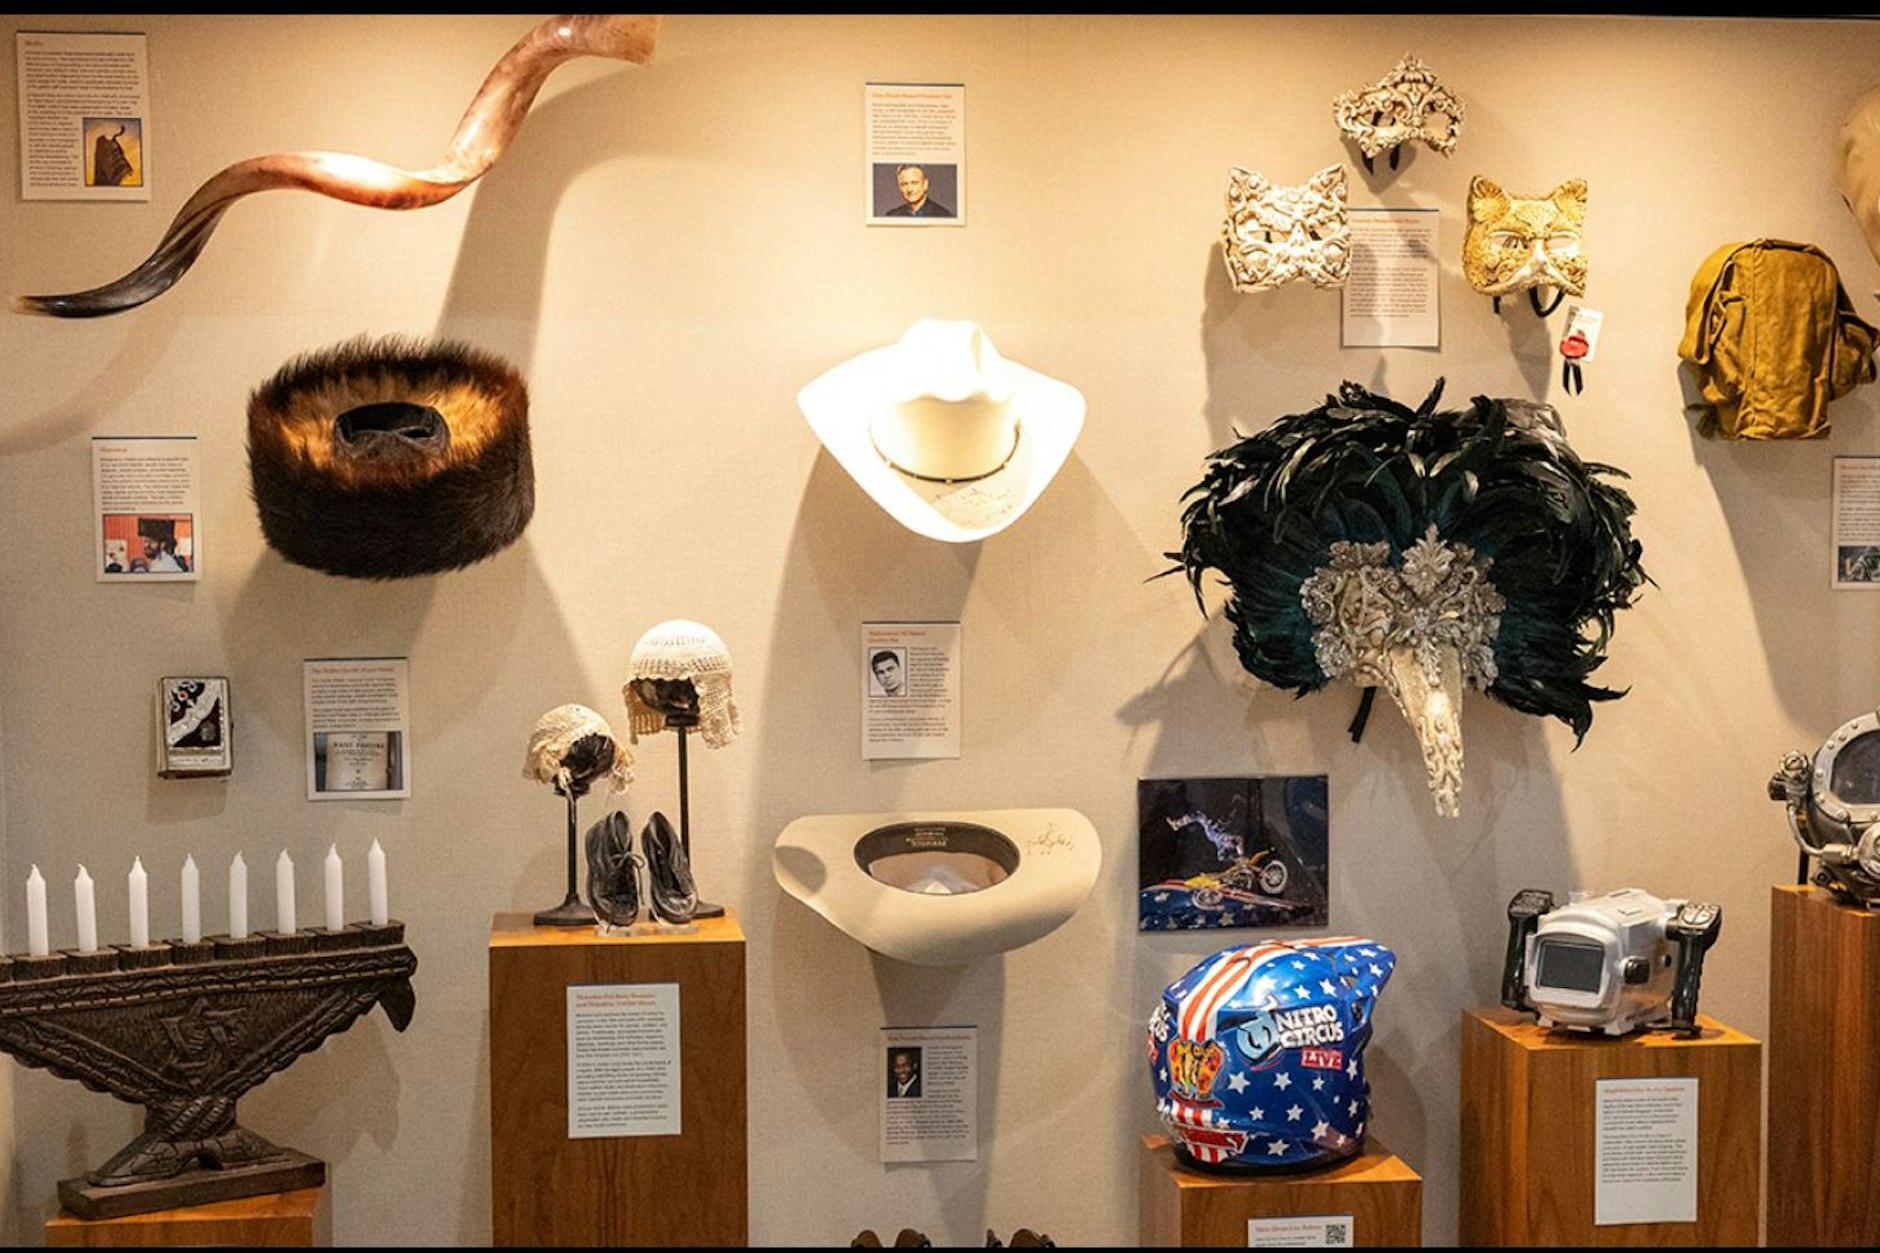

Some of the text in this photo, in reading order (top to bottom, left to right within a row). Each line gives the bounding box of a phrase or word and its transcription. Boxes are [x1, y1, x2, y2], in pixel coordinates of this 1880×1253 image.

[1276, 1005, 1336, 1032] NITRO
[1280, 1022, 1344, 1048] CIRCUS
[1303, 1050, 1342, 1068] LIVE
